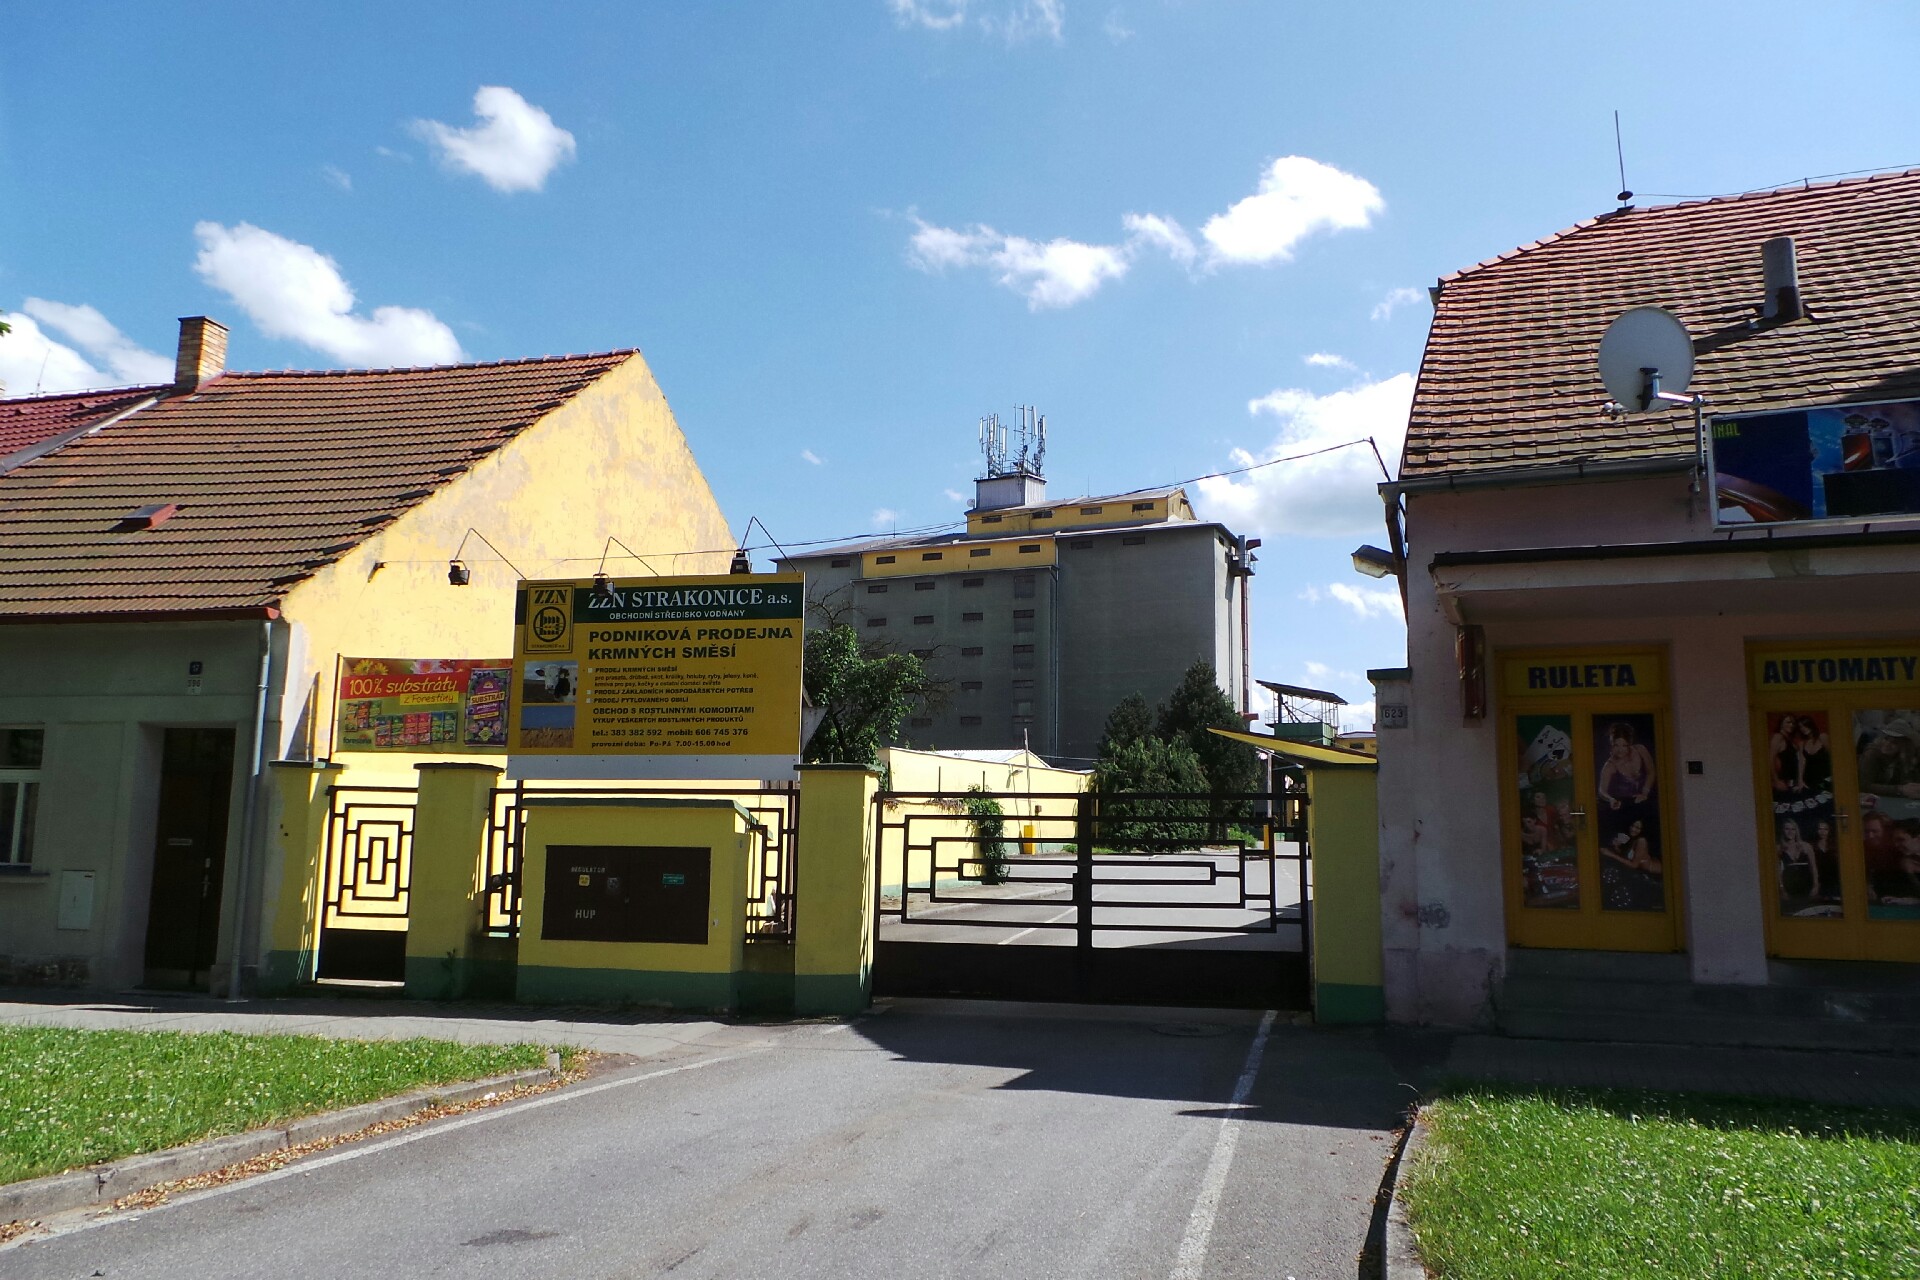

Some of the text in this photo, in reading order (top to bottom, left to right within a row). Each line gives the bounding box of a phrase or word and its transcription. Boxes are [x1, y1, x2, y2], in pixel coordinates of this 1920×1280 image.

[534, 589, 567, 604] ZZN
[631, 588, 763, 608] STRAKONICE
[767, 594, 792, 604] a.s.
[609, 609, 745, 620] OBCHODNÍ STŘEDISKO VODŇANY
[589, 627, 792, 642] PODNIKOVÁ PRODEJNA
[588, 643, 736, 660] KRMNÝCH SMĚSÍ
[1528, 663, 1637, 690] RULETA
[1763, 656, 1917, 684] AUTOMATY
[349, 675, 457, 695] 100% substráty
[639, 706, 696, 714] ROSTLINNÝMI
[1385, 708, 1403, 718] 623
[575, 909, 596, 919] HUP
